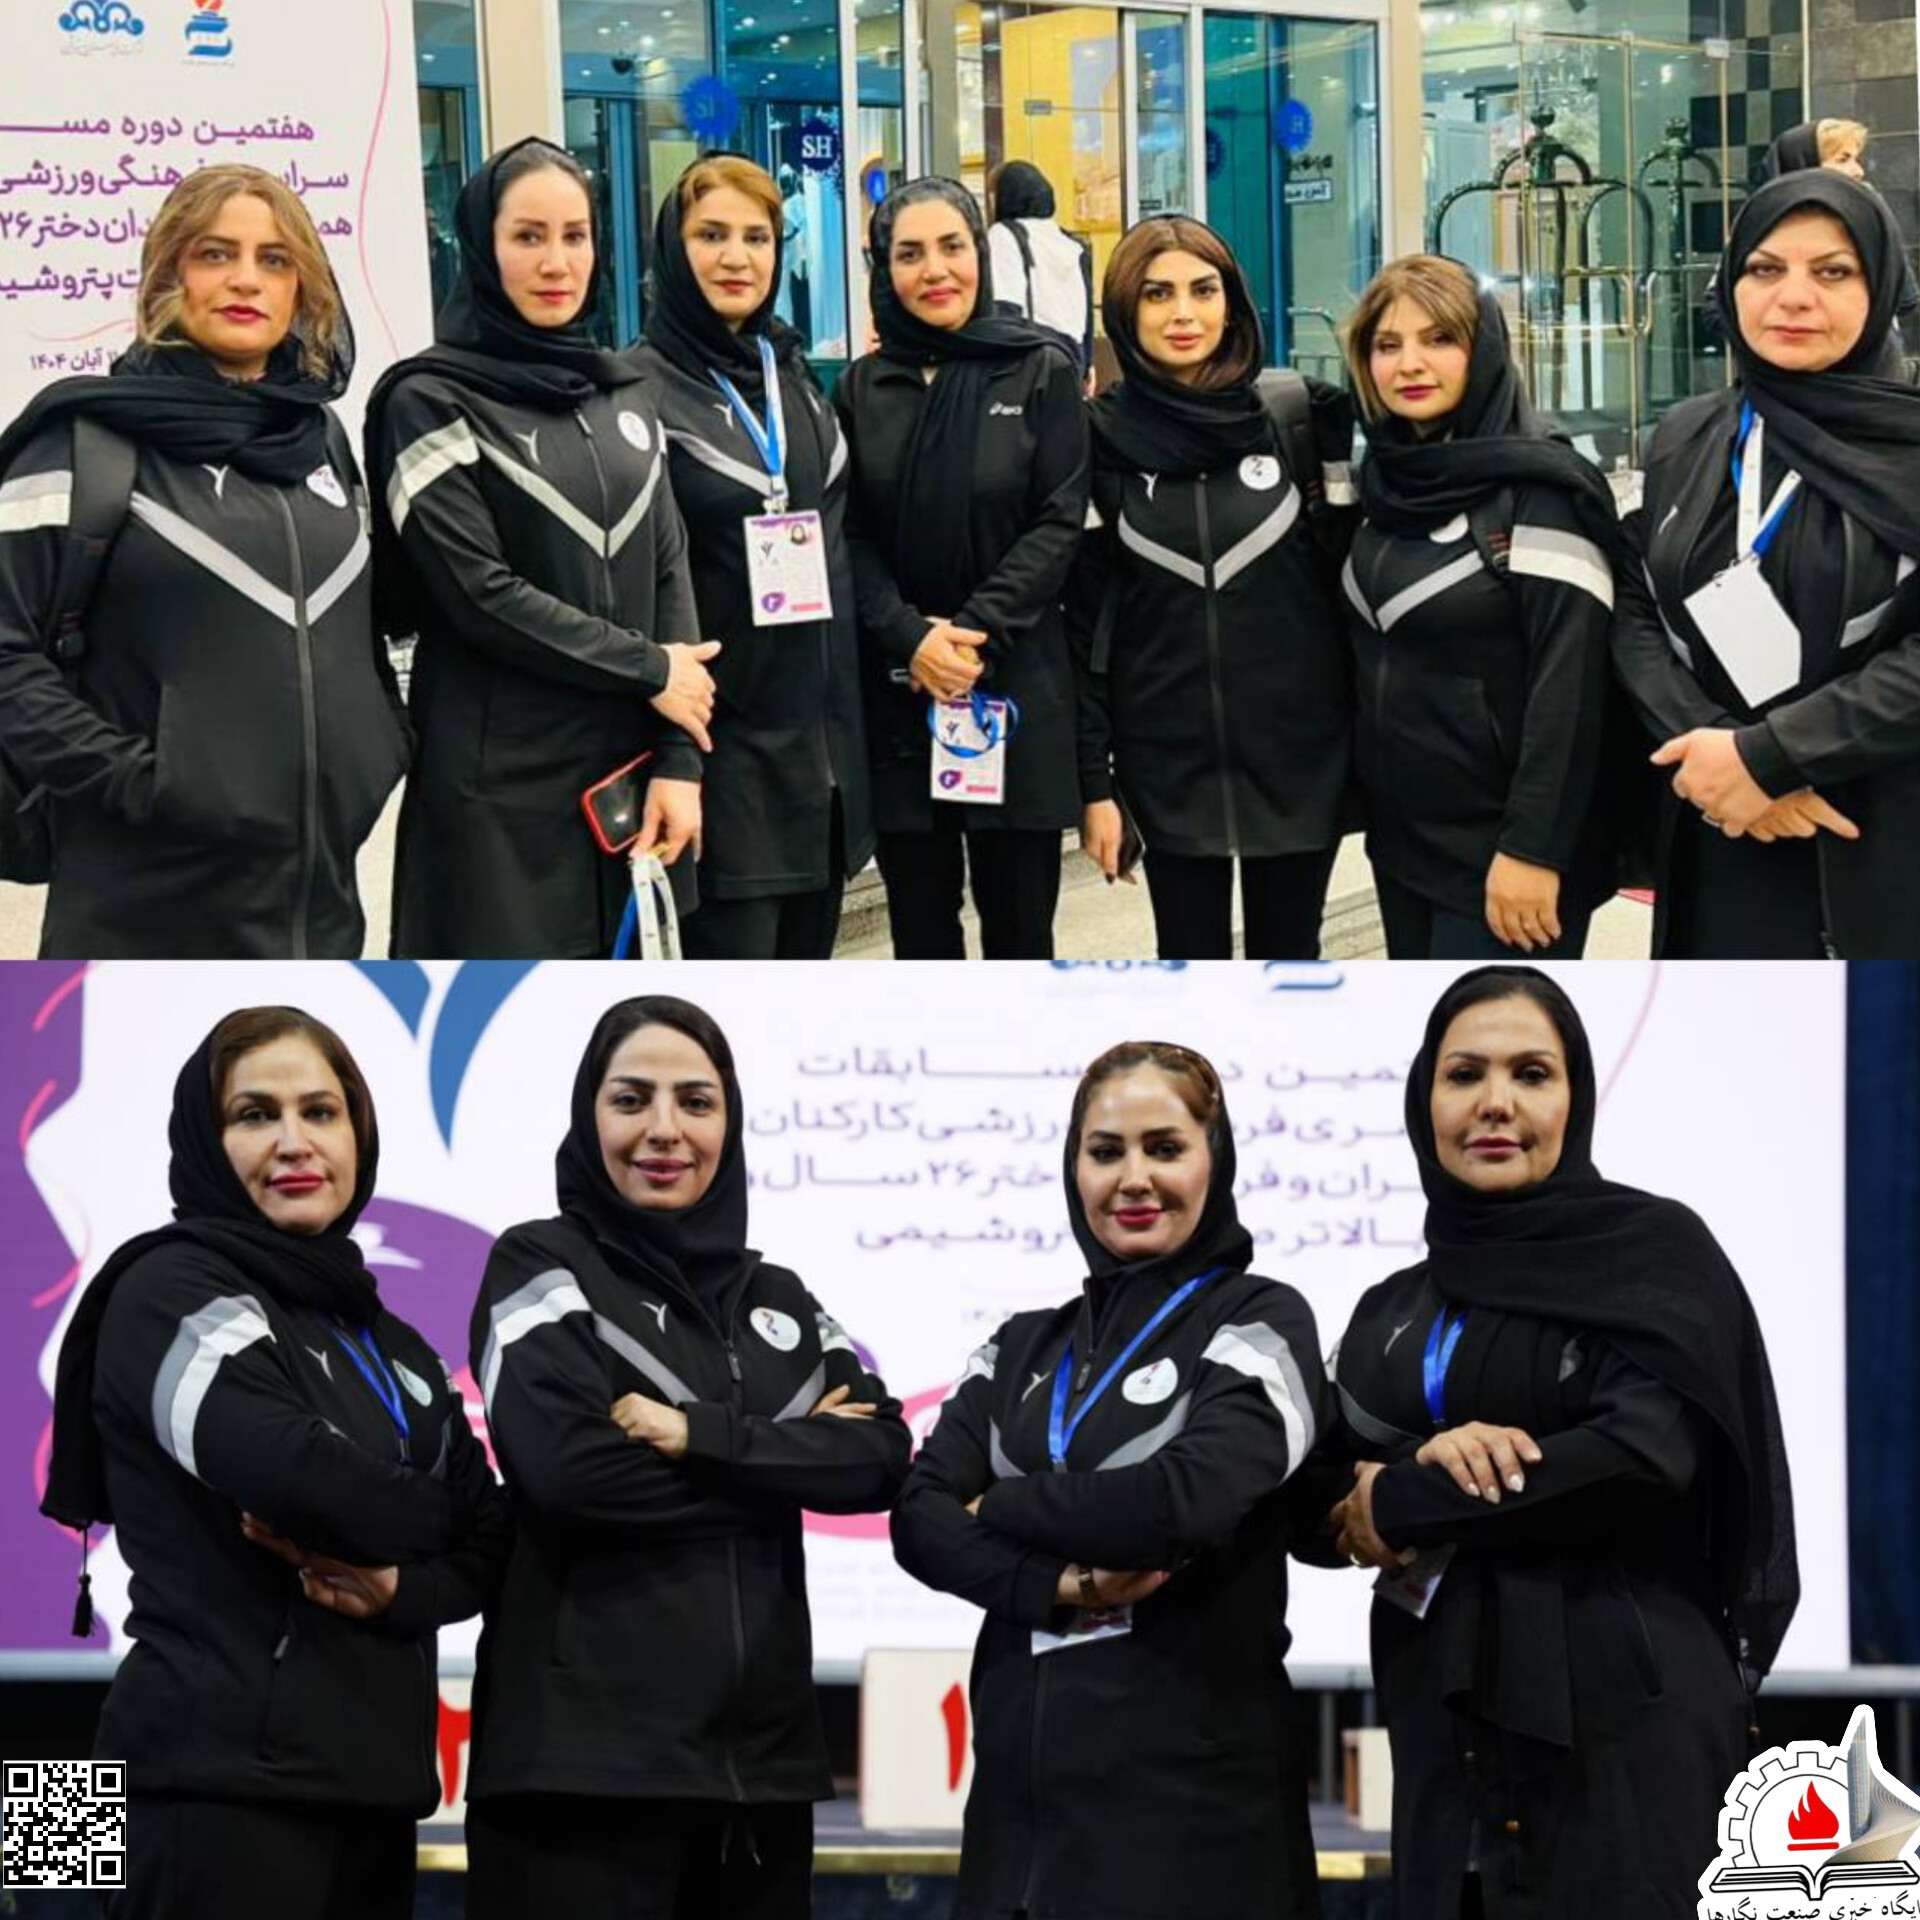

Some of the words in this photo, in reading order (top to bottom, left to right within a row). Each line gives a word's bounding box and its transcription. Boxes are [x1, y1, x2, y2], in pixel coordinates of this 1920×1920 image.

[121, 115, 182, 145] دوره
[193, 115, 315, 146] هفتمین
[801, 134, 833, 159] SH
[98, 154, 181, 196] هنگی
[31, 211, 101, 249] دختر
[0, 265, 114, 301] پتروشی
[30, 353, 67, 370] ۱۴۰۴
[70, 347, 103, 371] آبان
[798, 1046, 1084, 1085] سابقات
[750, 1100, 915, 1141] کارکنان
[918, 1107, 1068, 1143] رزشی
[763, 1152, 919, 1192] سال
[929, 1161, 976, 1187] ۲۶
[977, 1162, 1056, 1198] ختر
[857, 1216, 1070, 1255] روشیمی
[941, 1680, 968, 1793] ۱
